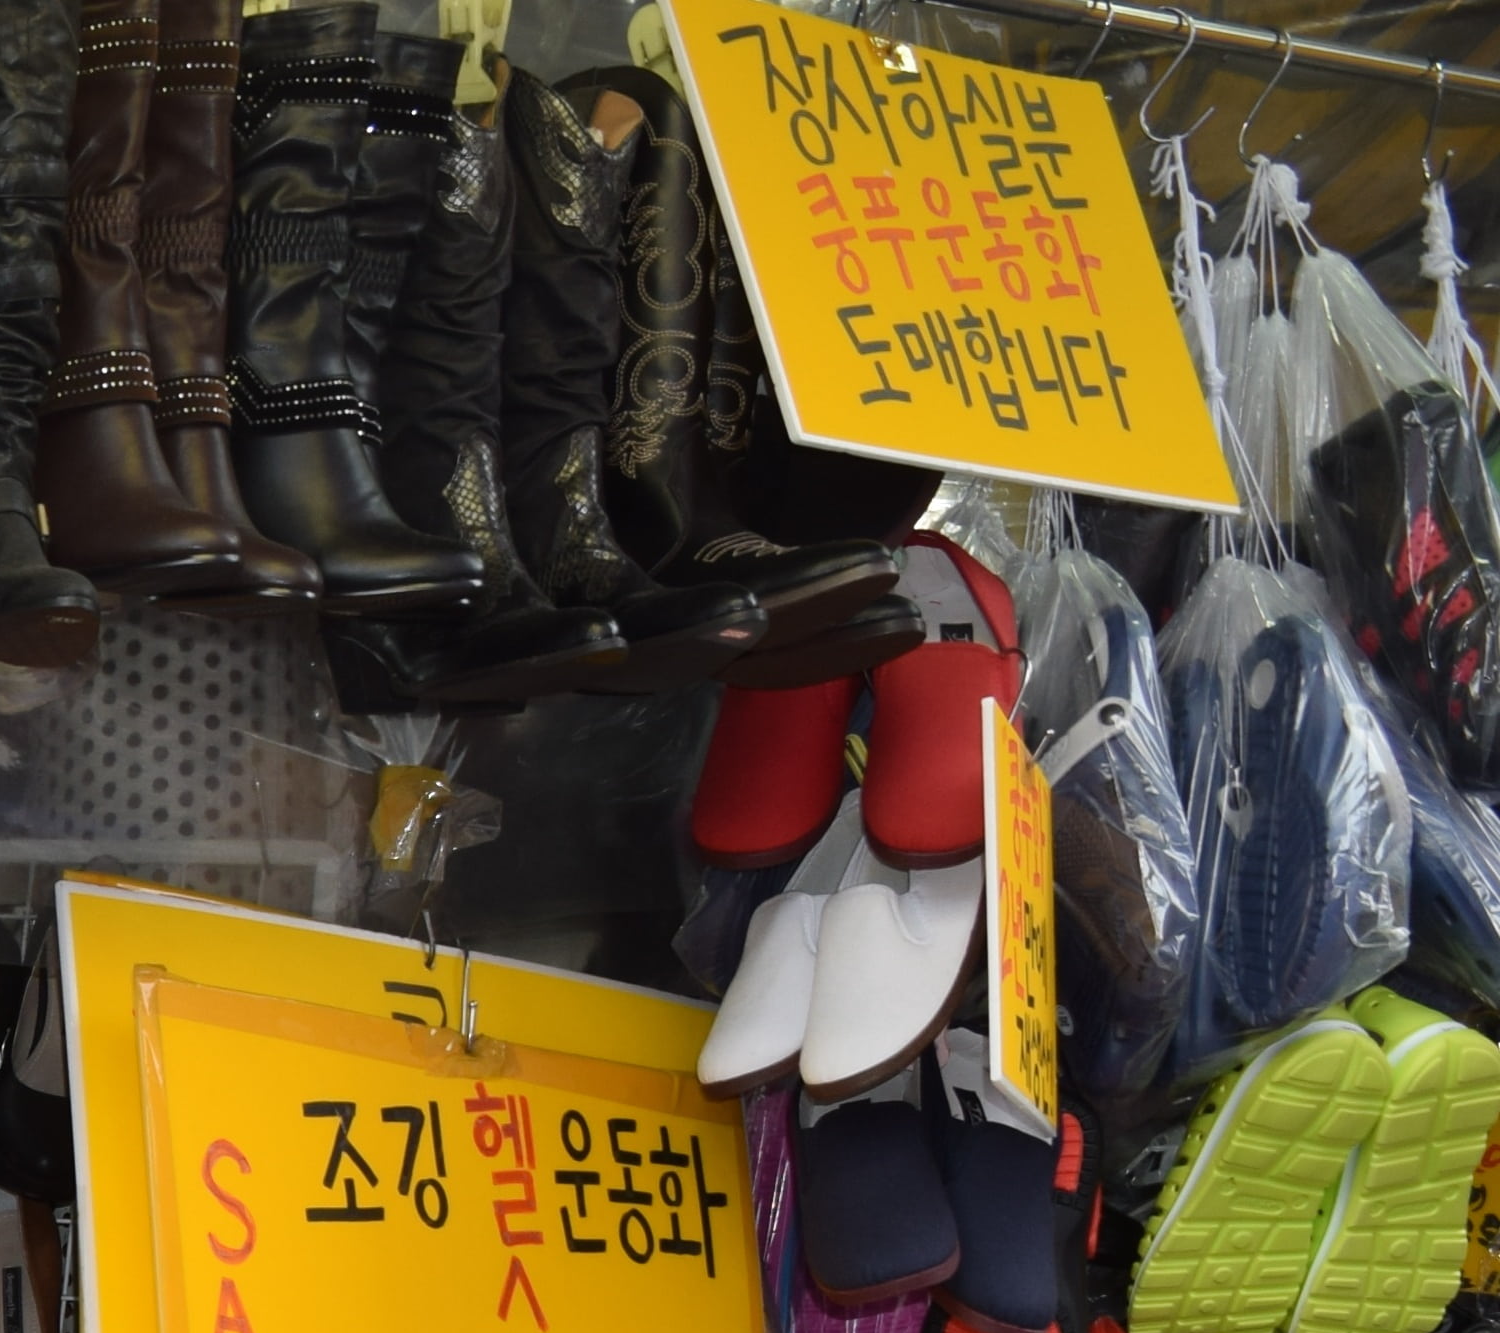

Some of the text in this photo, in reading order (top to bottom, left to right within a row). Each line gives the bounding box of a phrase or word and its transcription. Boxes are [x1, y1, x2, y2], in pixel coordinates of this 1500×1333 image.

[797, 170, 1102, 317] 쿵푸운동화
[835, 303, 1131, 433] 도매합니다
[303, 1100, 449, 1229] 조깅
[555, 1110, 728, 1279] 운동화
